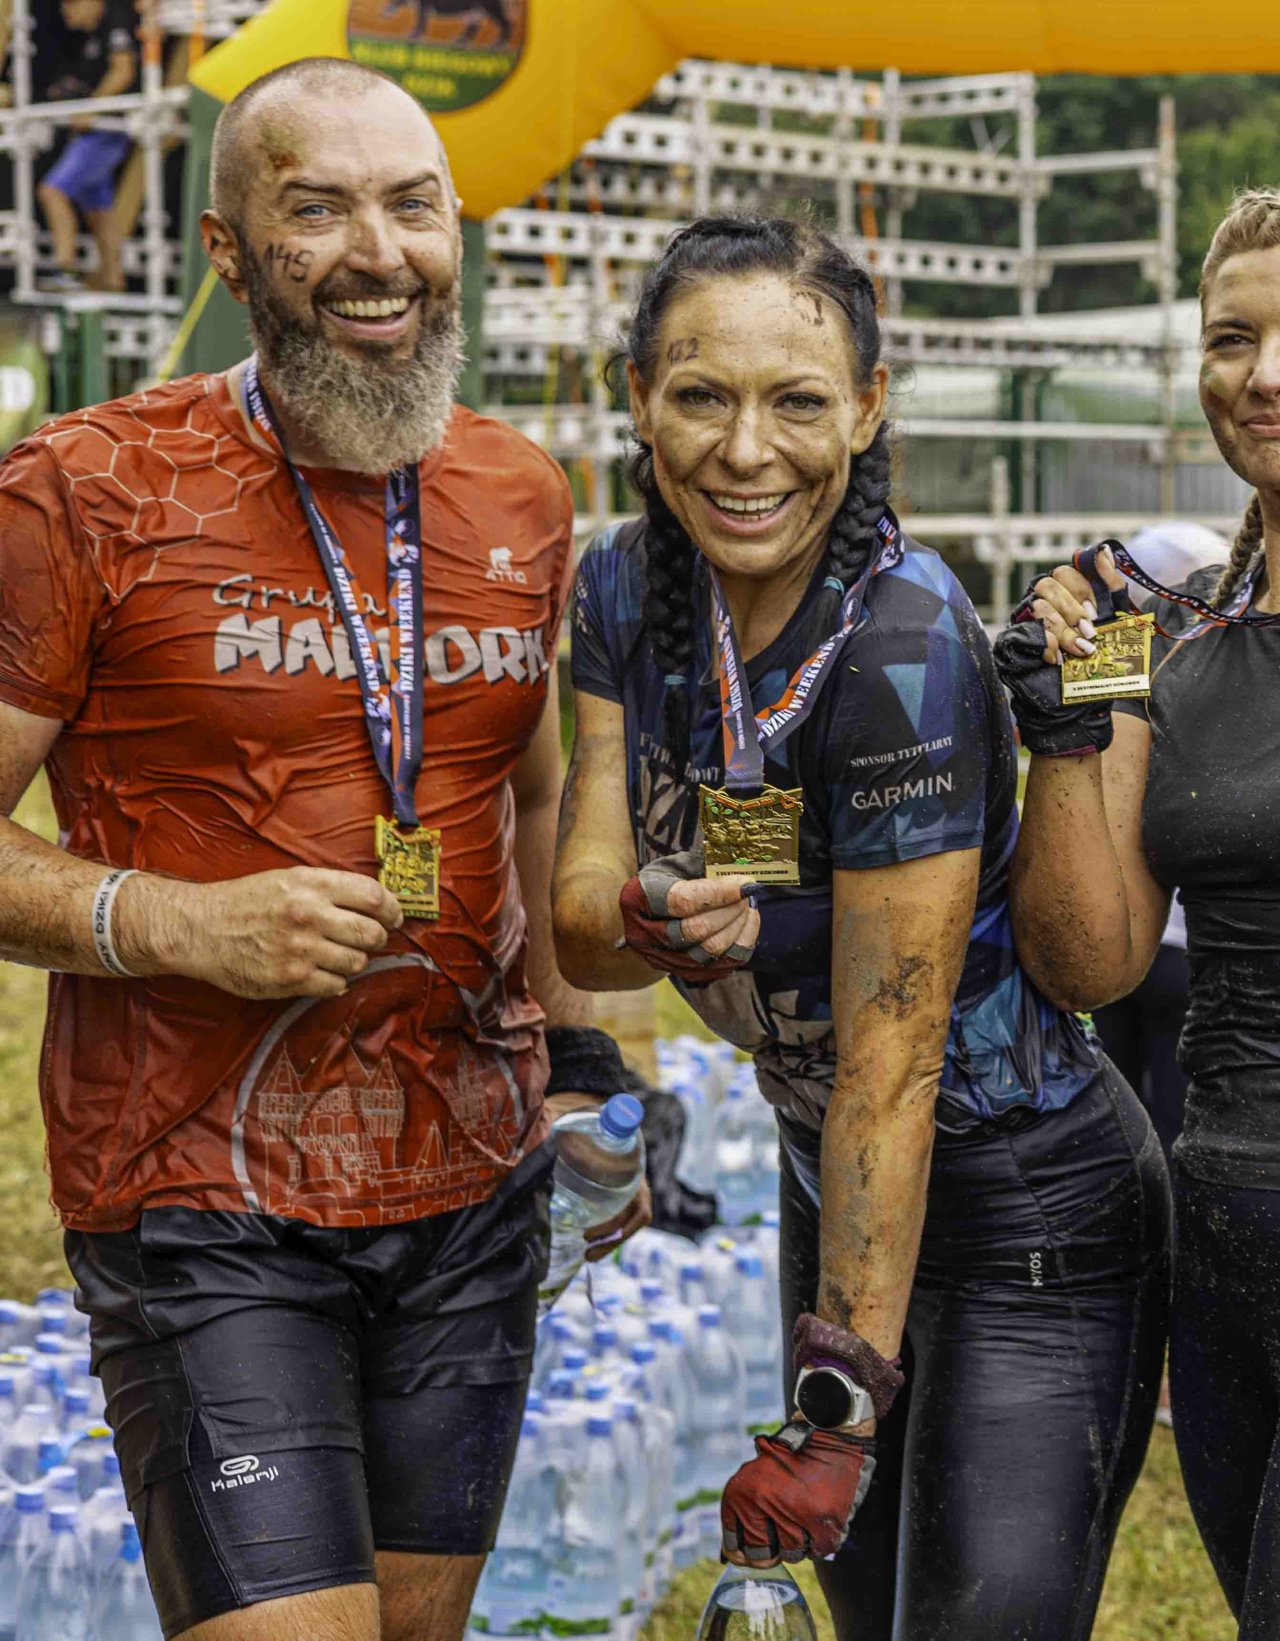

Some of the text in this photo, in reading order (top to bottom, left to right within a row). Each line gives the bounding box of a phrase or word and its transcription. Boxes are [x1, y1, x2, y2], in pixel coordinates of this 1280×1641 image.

[332, 566, 381, 693] DZIKI WEEKEND
[761, 639, 836, 739] DZIKI WEEKEND
[850, 752, 896, 768] SPONSOR
[851, 772, 953, 810] GARMIN
[1030, 1251, 1043, 1287] MYOS
